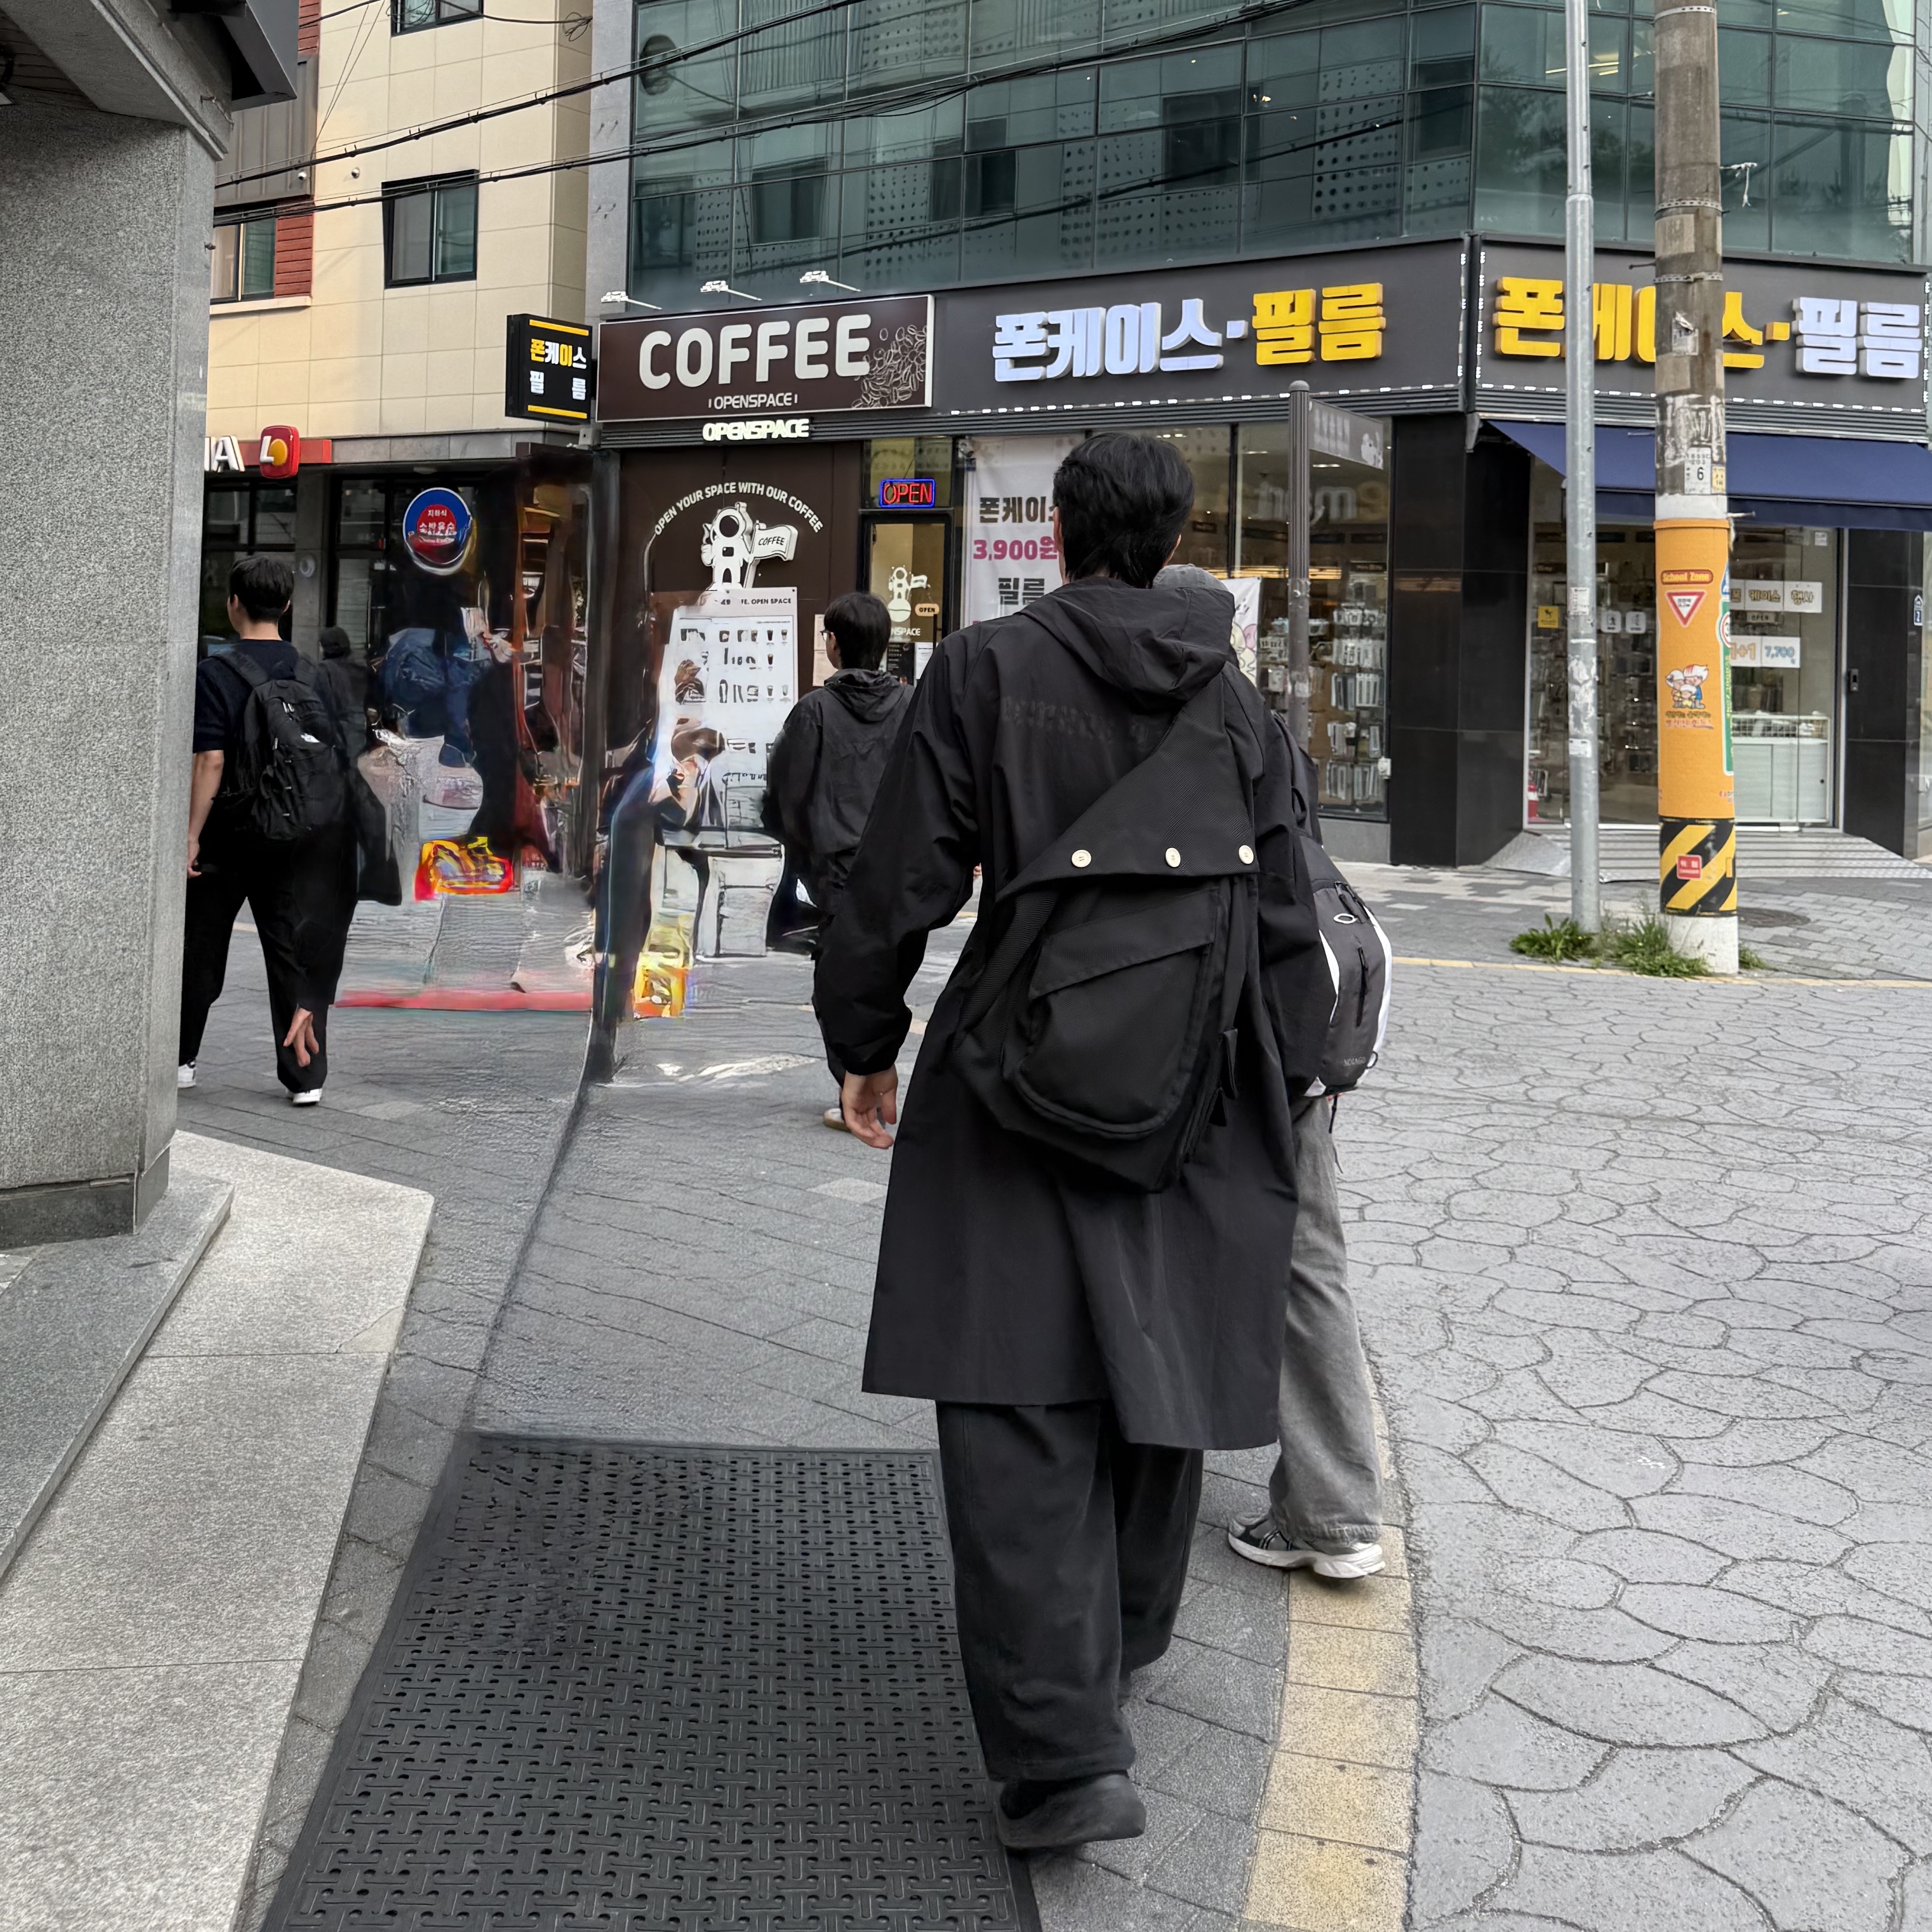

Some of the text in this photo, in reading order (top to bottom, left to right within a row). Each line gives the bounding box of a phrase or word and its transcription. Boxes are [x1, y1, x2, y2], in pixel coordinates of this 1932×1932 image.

[531, 339, 587, 369] 폰케이스
[640, 314, 871, 389] COFFEE
[714, 392, 792, 409] OPENSPACE
[702, 419, 809, 441] OPENSPACE
[1697, 467, 1704, 480] 6
[883, 482, 932, 504] OPEN
[654, 482, 823, 536] OPEN YOUR SPACE WITH OUR COFFEE
[979, 496, 1055, 523] 폰케이
[758, 536, 785, 546] COFFEE
[998, 578, 1045, 605] 필름
